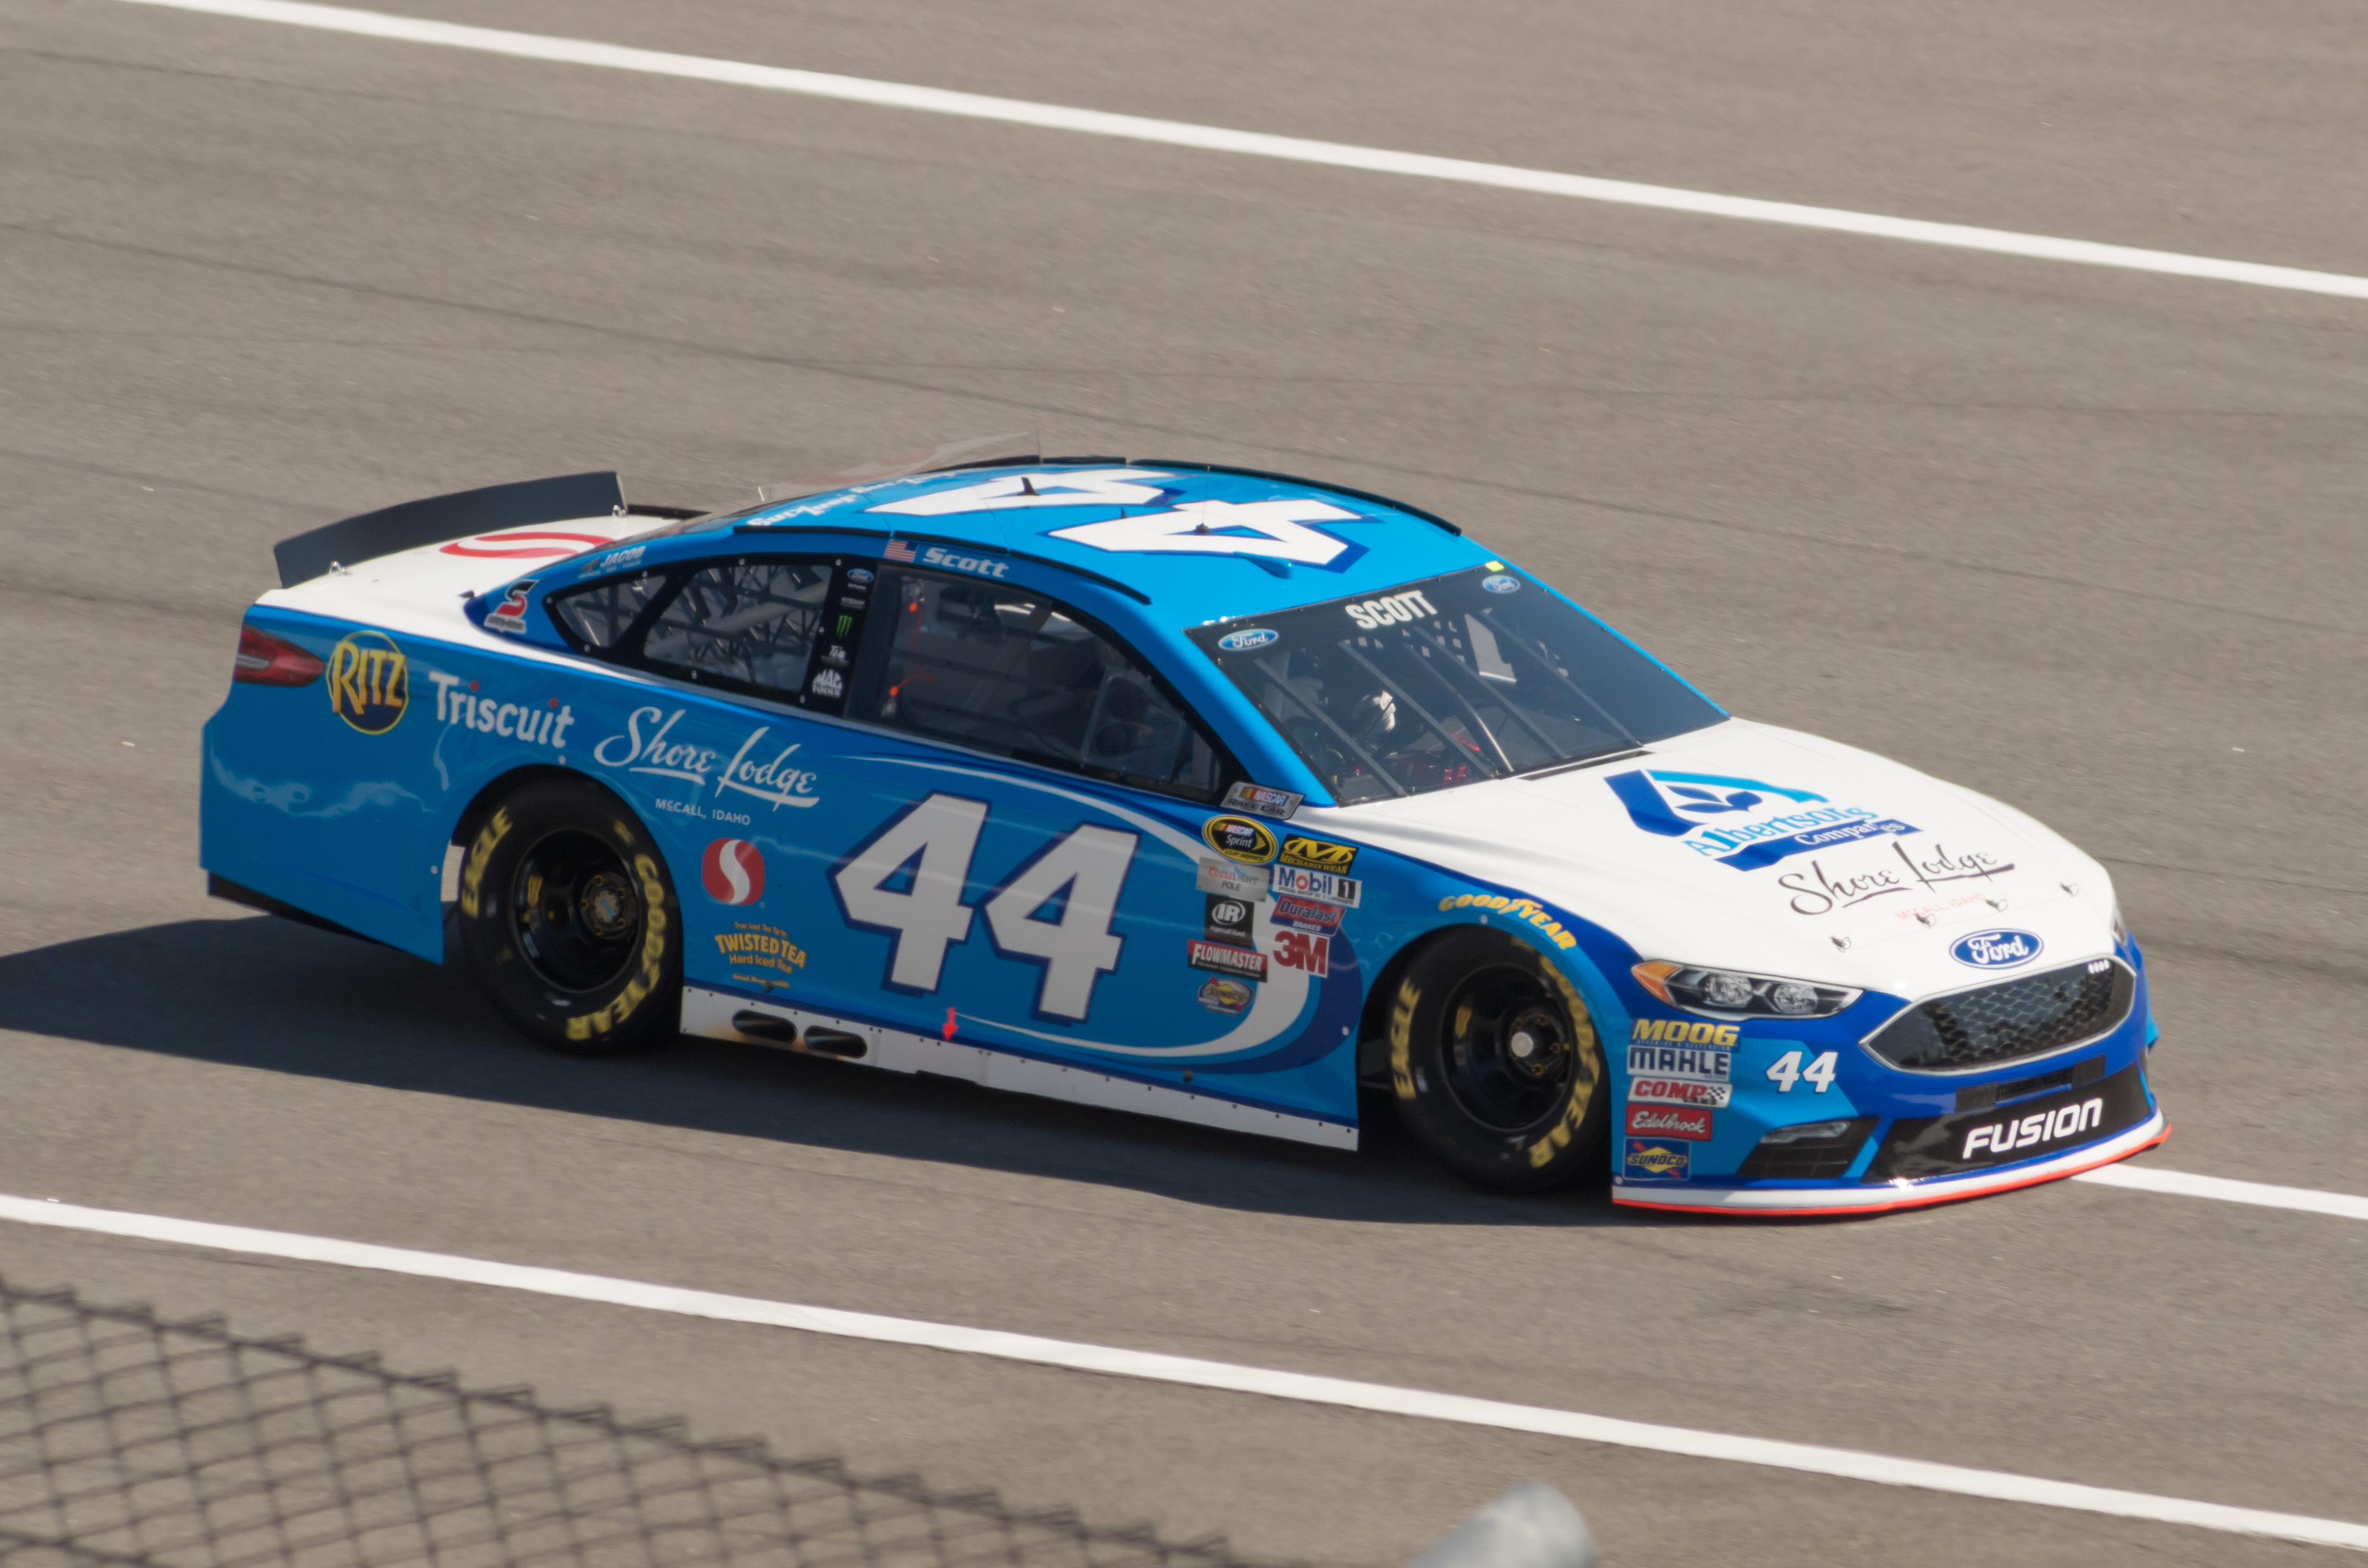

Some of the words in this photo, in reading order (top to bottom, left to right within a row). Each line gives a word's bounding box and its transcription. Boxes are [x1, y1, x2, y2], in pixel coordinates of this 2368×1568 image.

[923, 547, 1008, 578] Scott
[1488, 576, 1516, 592] Ford
[1345, 590, 1438, 630] SCOTT
[1232, 631, 1270, 649] Ford
[331, 640, 407, 716] RITZ
[429, 670, 574, 749] Triscuit
[593, 706, 716, 775] Shore
[715, 726, 819, 812] Lodge
[1227, 799, 1259, 810] RACE
[1260, 805, 1285, 815] CAR
[1253, 789, 1288, 806] NASCAR
[712, 808, 751, 825] IDAHO
[1225, 824, 1255, 836] NASCAR
[1226, 834, 1253, 848] Sprint
[1794, 822, 1906, 846] Companes
[1280, 853, 1322, 870] MECHANIX
[1323, 864, 1348, 875] WEAR
[1222, 881, 1241, 891] POLE
[1232, 874, 1258, 885] LIGHT
[1278, 867, 1332, 895] Mobil
[1778, 860, 1900, 916] Shore
[1891, 841, 2002, 893] Lodge
[831, 791, 1141, 1023] 44
[1279, 900, 1339, 924] Duralast
[1947, 893, 1987, 907] IDAHO
[1217, 903, 1241, 922] IR
[1438, 894, 1577, 950] GOODYEAR
[1292, 921, 1322, 932] BRAKES
[714, 933, 780, 955] TWISTED
[781, 938, 807, 970] TEA
[1191, 943, 1264, 972] FLOWMASTER
[1273, 930, 1328, 975] 3M
[1968, 933, 2030, 964] Ford
[729, 953, 753, 965] Hard
[755, 954, 776, 969] Iced
[777, 958, 793, 974] Tea
[1632, 1018, 1741, 1047] MOOG
[1629, 1047, 1728, 1076] MAHLE
[1765, 1050, 1838, 1093] 44
[1634, 1080, 1708, 1100] COMP
[1632, 1111, 1706, 1133] Edelbrock
[1962, 1097, 2103, 1160] FUSION
[1629, 1154, 1687, 1166] SUNOCO
